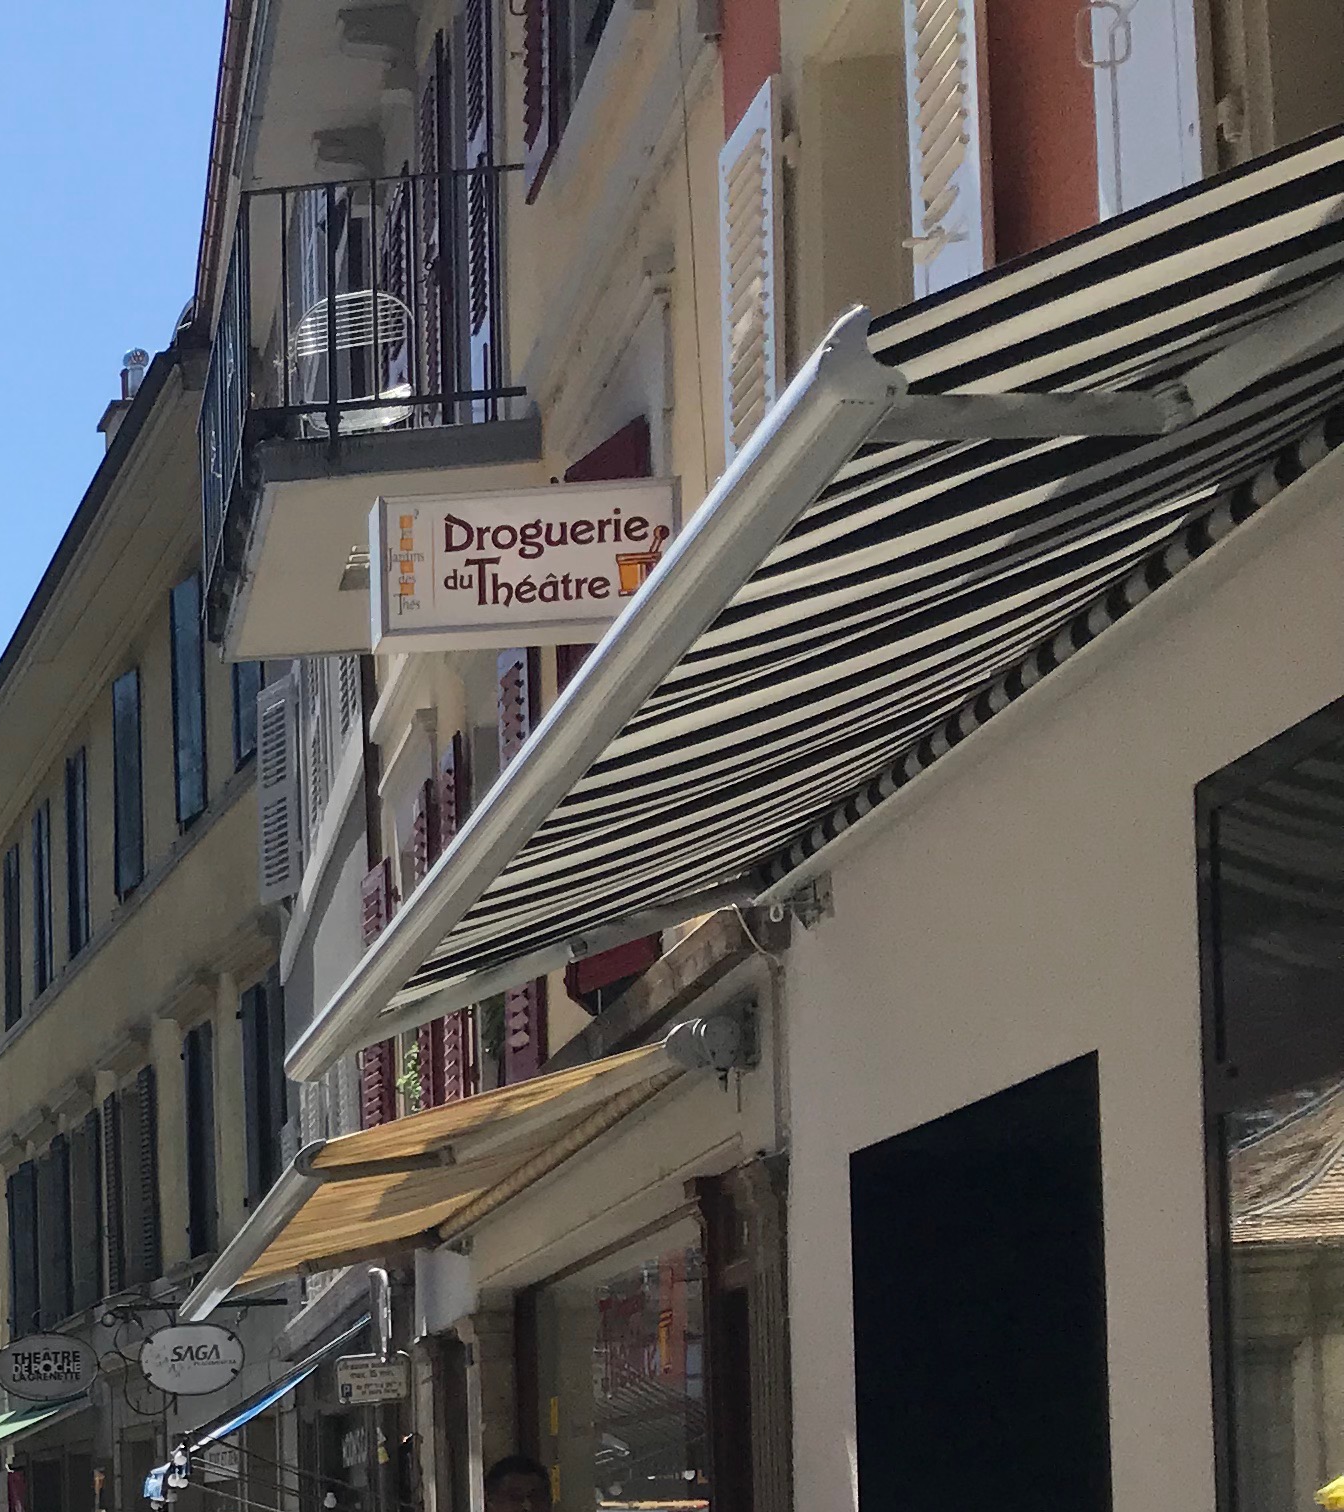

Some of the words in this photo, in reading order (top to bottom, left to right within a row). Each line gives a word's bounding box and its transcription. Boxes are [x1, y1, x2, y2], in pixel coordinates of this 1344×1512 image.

[443, 507, 650, 560] Droguerie
[443, 568, 474, 590] du
[464, 555, 612, 607] Théâtre
[32, 1360, 81, 1374] POCHE
[171, 1344, 220, 1362] SAGA
